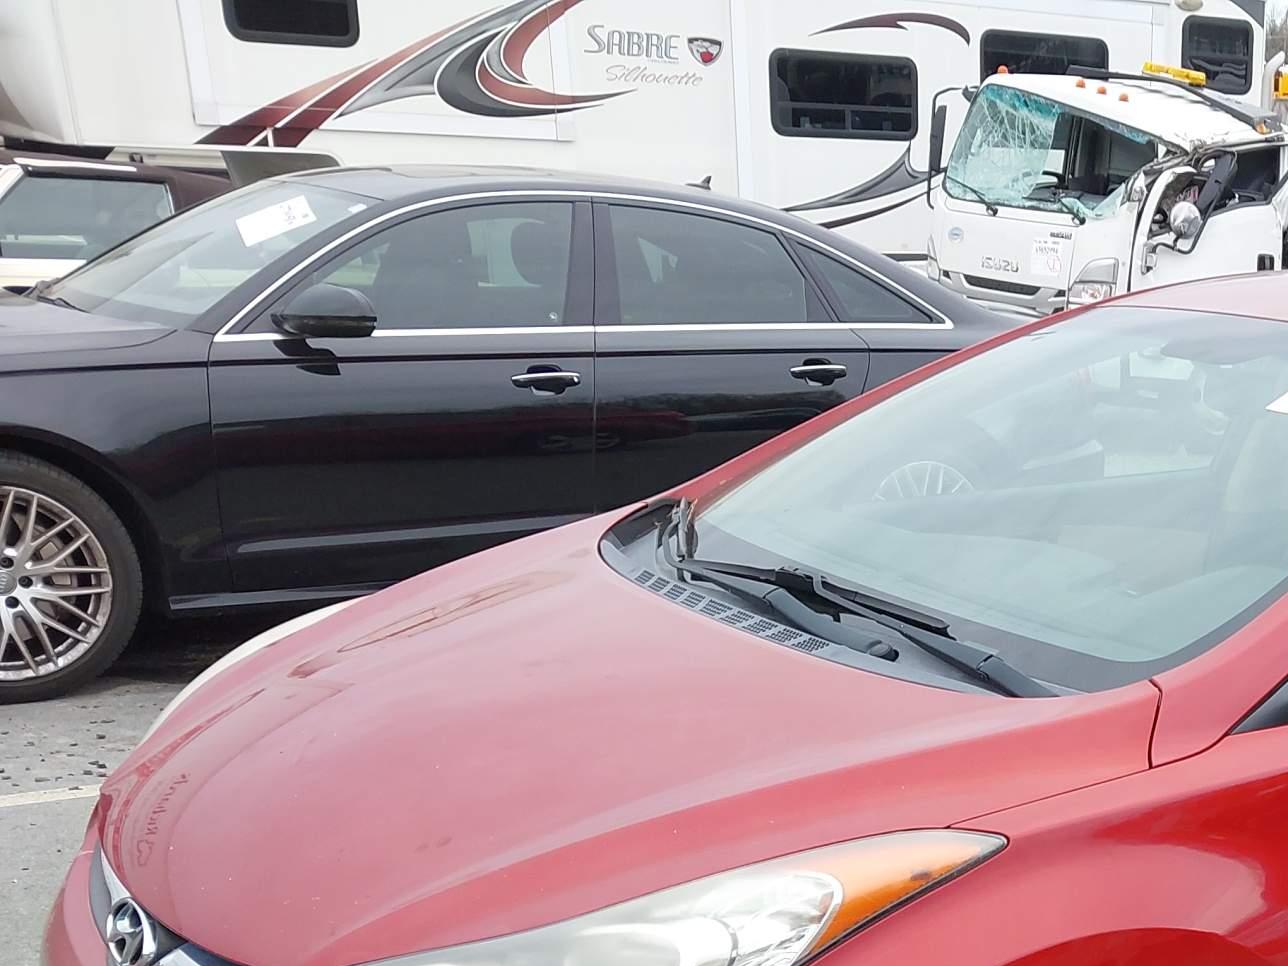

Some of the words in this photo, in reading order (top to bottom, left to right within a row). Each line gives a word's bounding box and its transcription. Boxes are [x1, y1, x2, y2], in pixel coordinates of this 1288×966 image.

[584, 25, 680, 60] SABRE
[605, 64, 703, 86] Silhouette
[981, 256, 1019, 272] ISUZU
